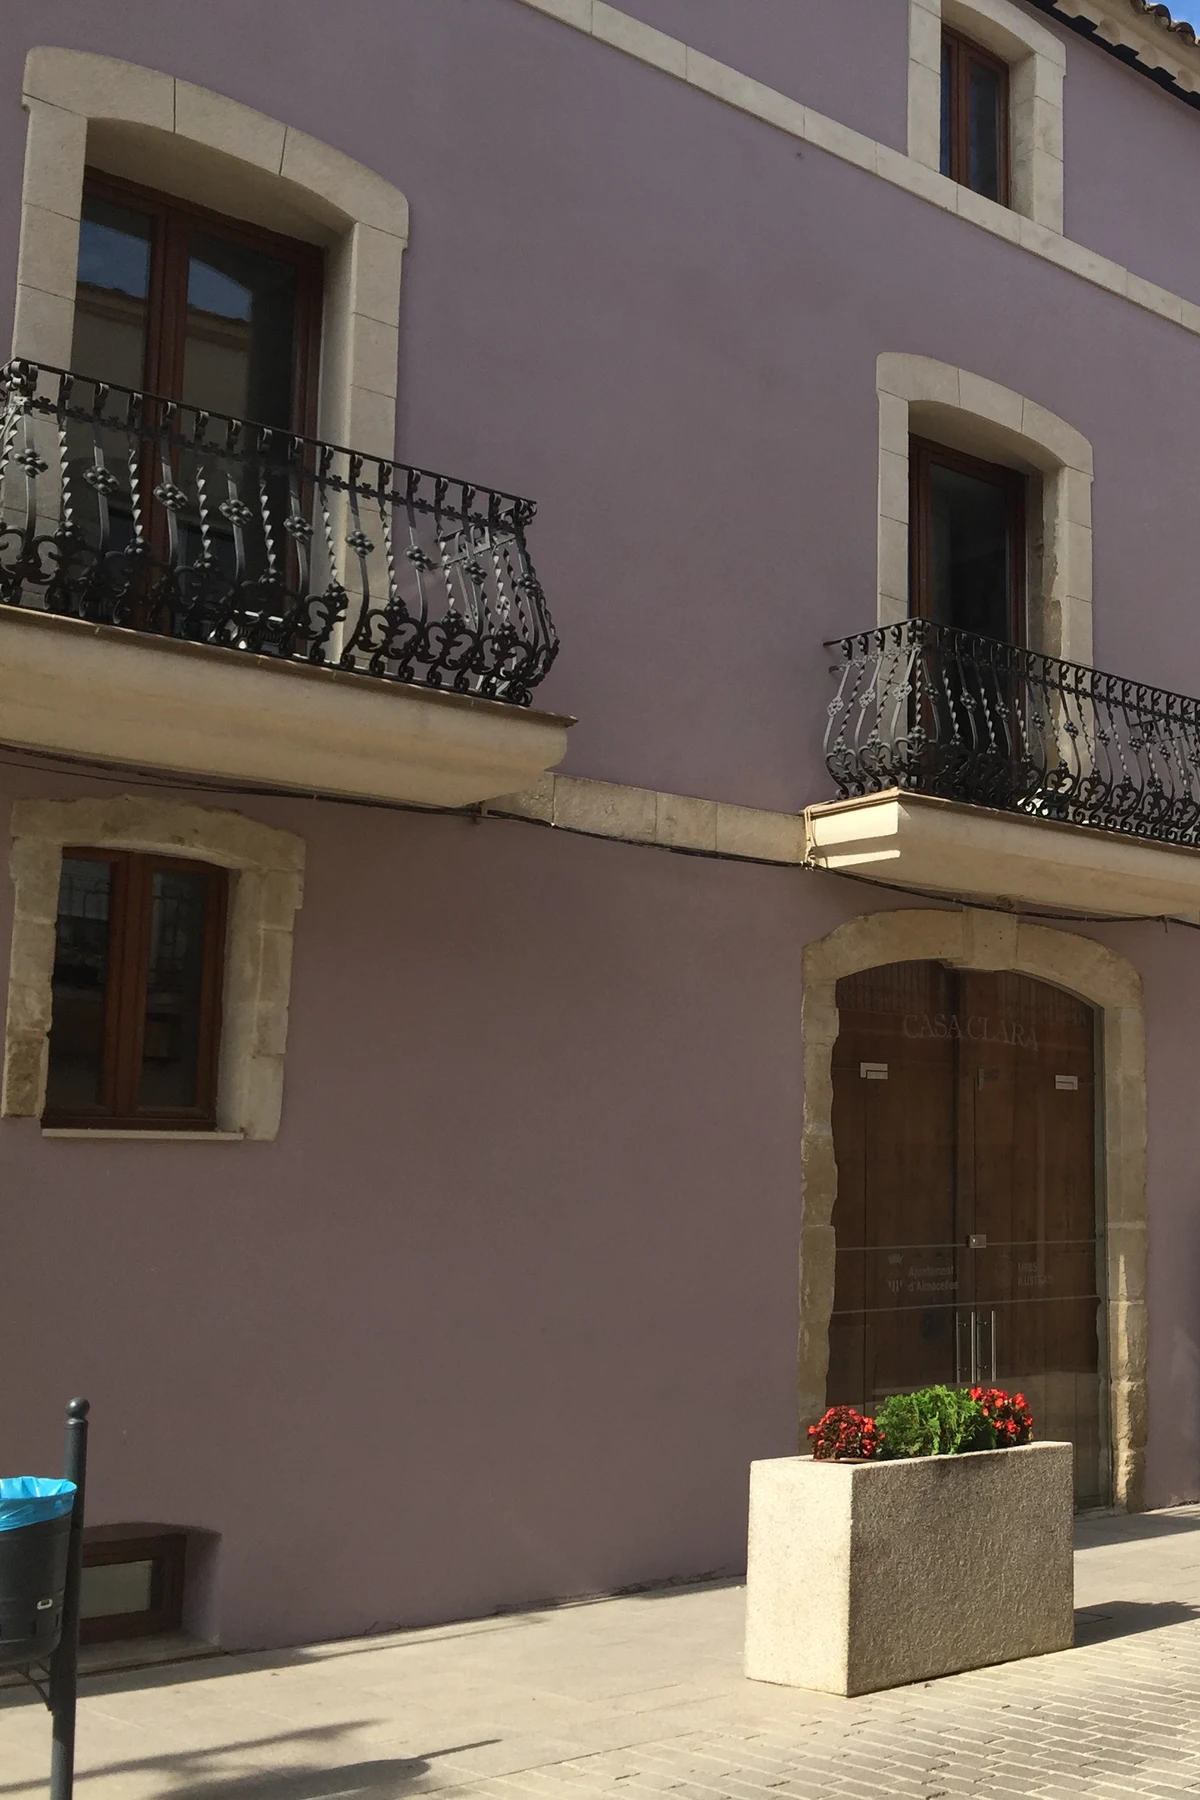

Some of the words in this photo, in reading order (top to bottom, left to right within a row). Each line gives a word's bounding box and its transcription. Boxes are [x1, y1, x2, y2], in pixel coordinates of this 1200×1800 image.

[903, 1014, 964, 1039] CASA
[967, 1016, 1039, 1052] CLARA
[908, 1265, 955, 1279] Ajuntament
[907, 1279, 959, 1292] d'Almacelles
